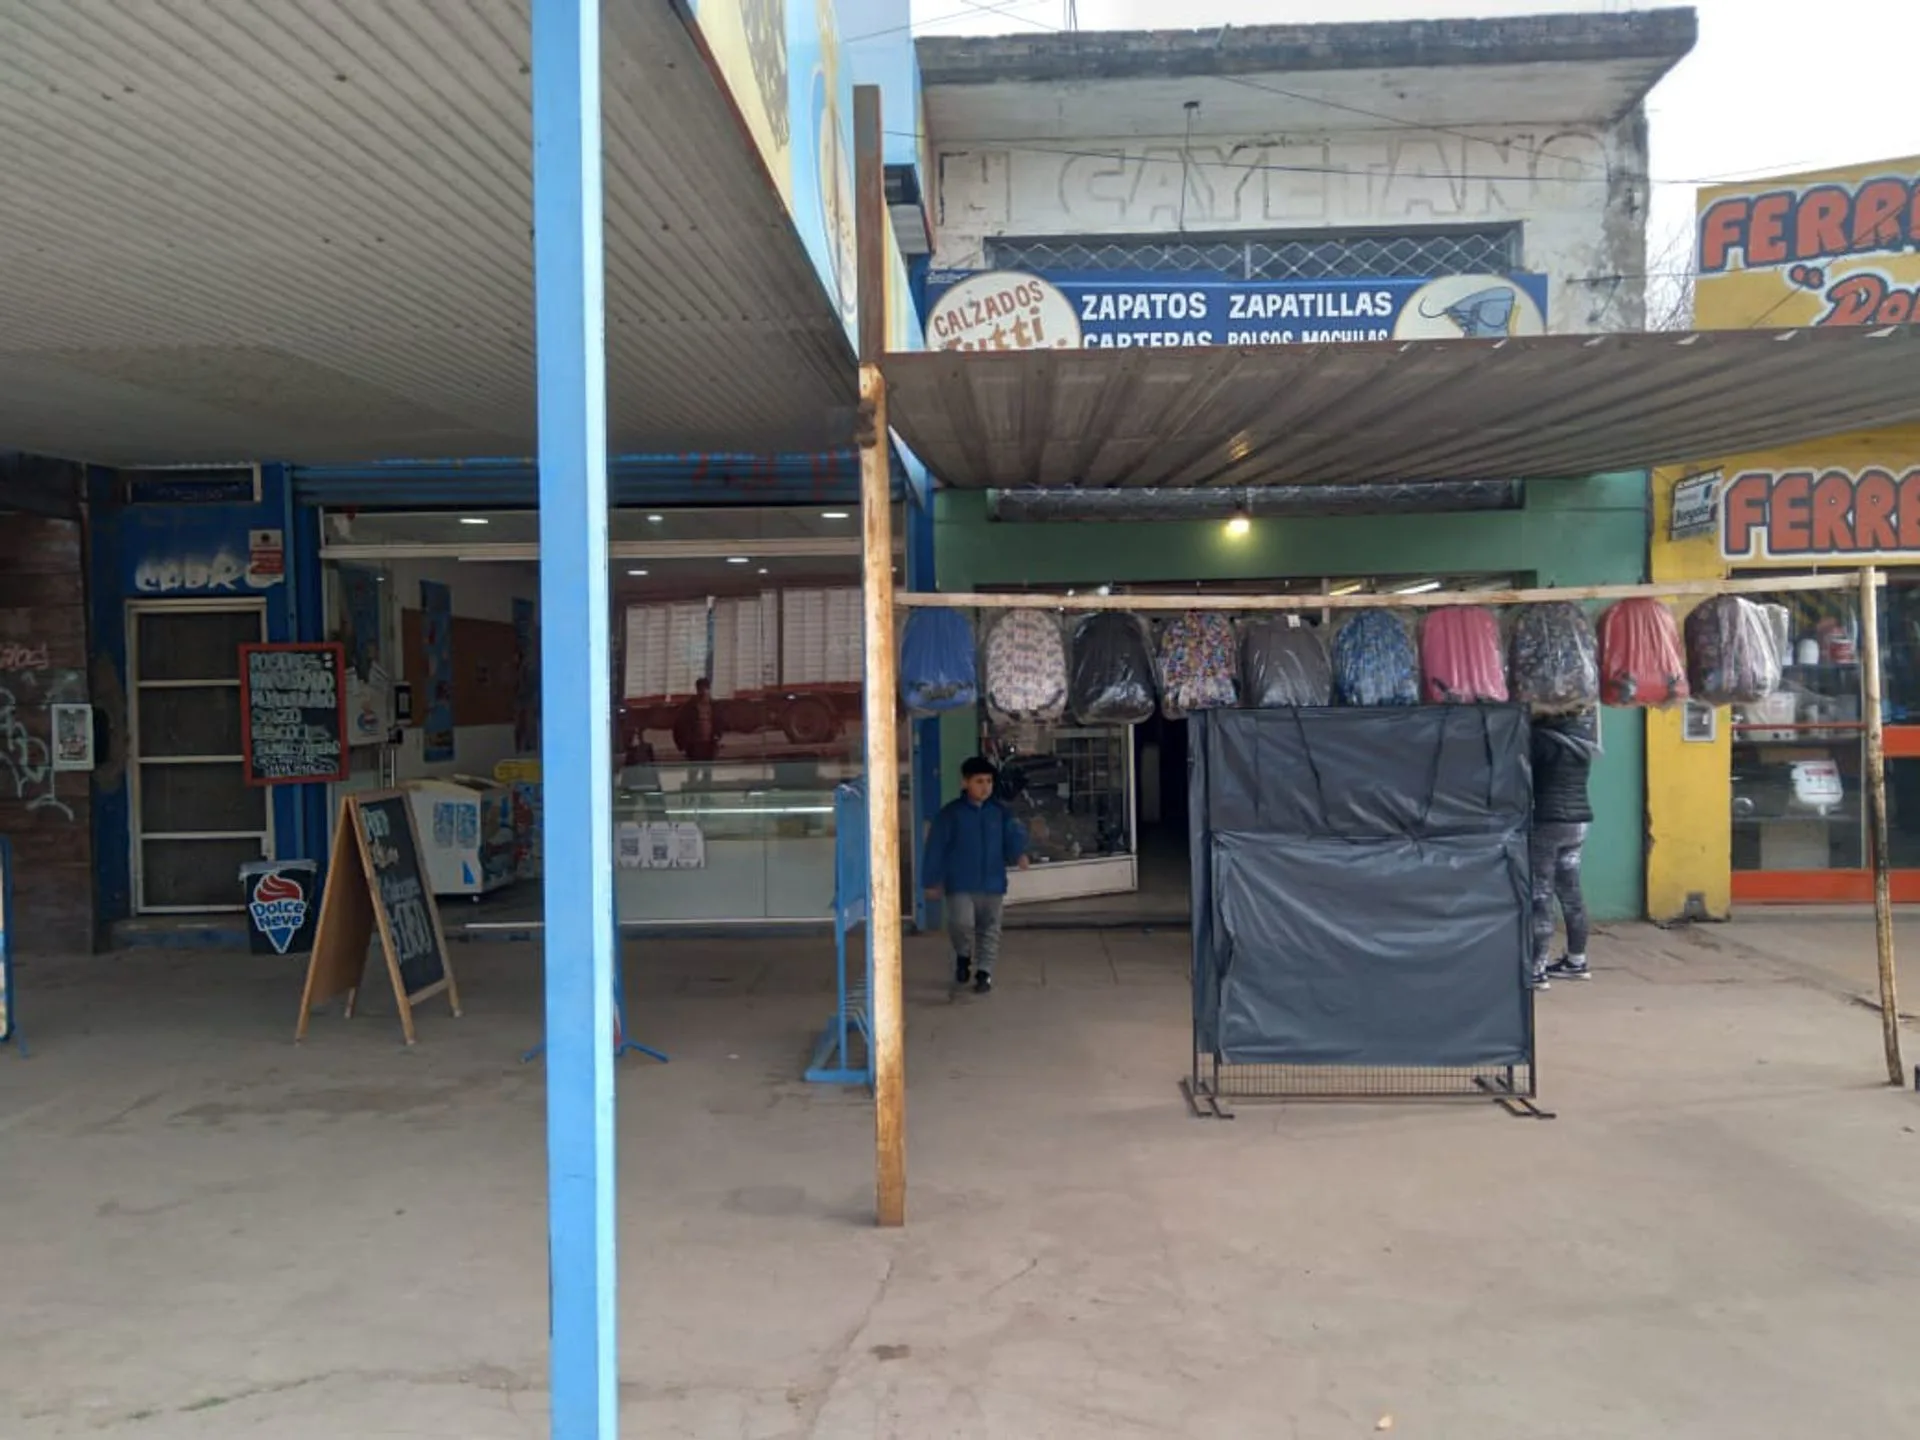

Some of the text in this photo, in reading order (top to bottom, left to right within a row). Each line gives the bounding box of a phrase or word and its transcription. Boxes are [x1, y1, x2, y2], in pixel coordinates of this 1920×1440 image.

[1700, 174, 1920, 271] FERR
[933, 280, 1045, 337] CALZADOS
[1081, 290, 1393, 320] ZAPATOS ZAPATILLAS
[253, 901, 304, 917] Dolce
